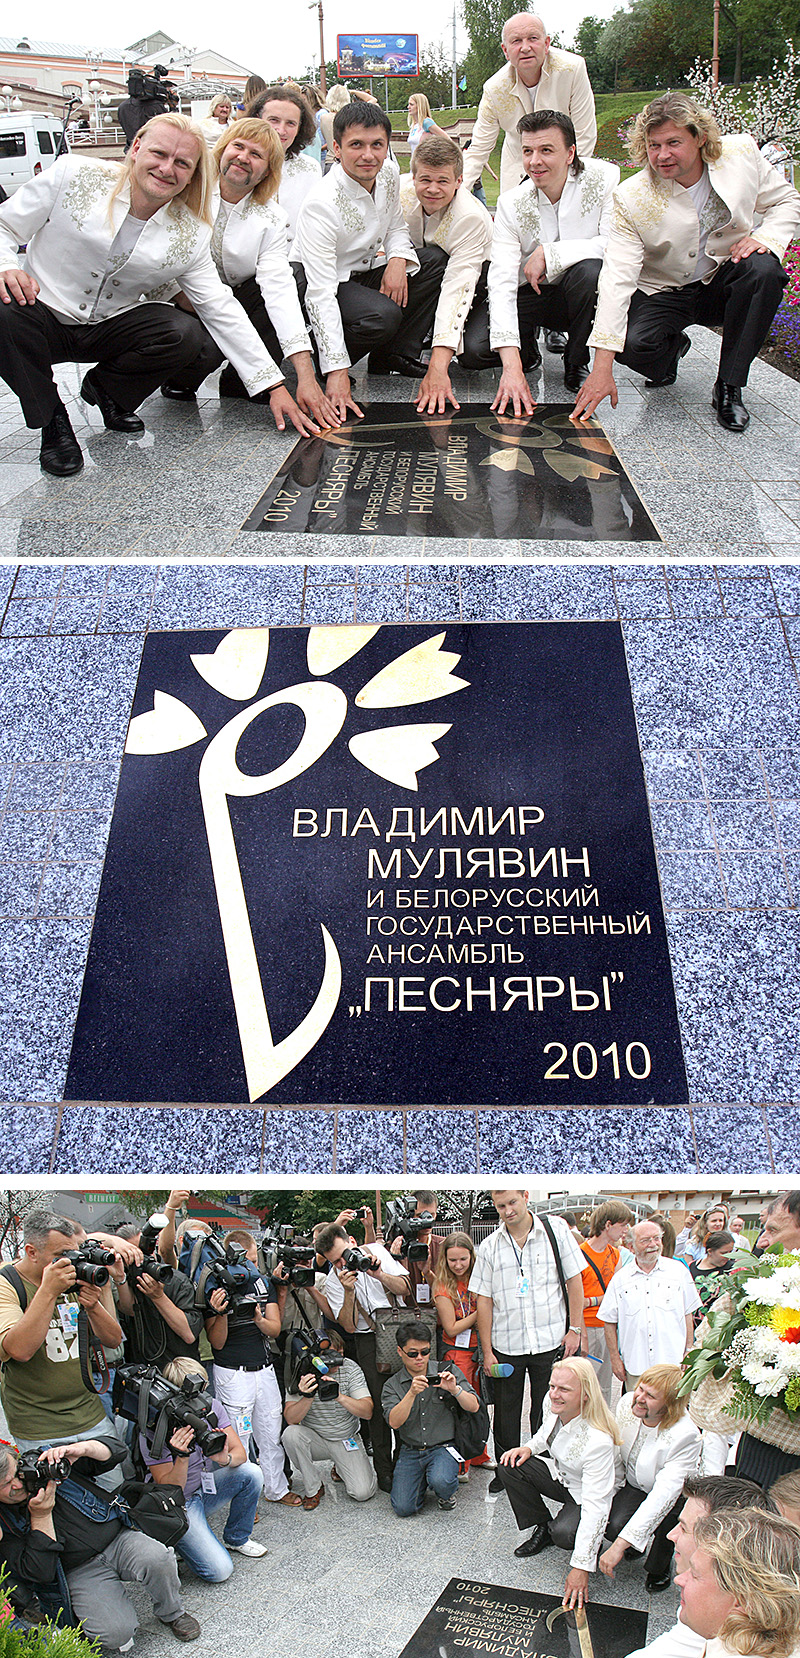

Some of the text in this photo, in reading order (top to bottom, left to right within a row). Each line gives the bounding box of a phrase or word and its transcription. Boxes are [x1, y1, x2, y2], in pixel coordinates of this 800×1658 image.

[353, 451, 380, 490] АНСАМБЛЬ
[408, 451, 440, 514] МУЛЯВИН
[443, 435, 468, 501] ВЛАДИМИР
[359, 451, 397, 531] ГОСУДАРСТВЕННЫЙ
[385, 458, 412, 516] БЕЛОРУССКИЙ
[263, 490, 302, 522] 2010
[292, 806, 545, 843] ВЛАДИМИР
[367, 847, 591, 880] МУЛЯВИН
[366, 884, 600, 909] И БЕЛОРУССКИЙ
[366, 910, 652, 940] ГОСУДАРСТВЕННЫЙ
[366, 943, 525, 965] АНСАМБЛЬ
[543, 1041, 652, 1080] 2010
[88, 1194, 116, 1203] BELWEST
[96, 1350, 106, 1371] Canon
[456, 1582, 492, 1595] 2010
[435, 1605, 536, 1631] ГОСУДАРСТВЕННЫЙ
[448, 1615, 523, 1636] БЕЛОРУССКИЙ
[482, 1609, 538, 1625] АНСАМБЛЬ
[444, 1622, 531, 1648] МУЛЯВИН
